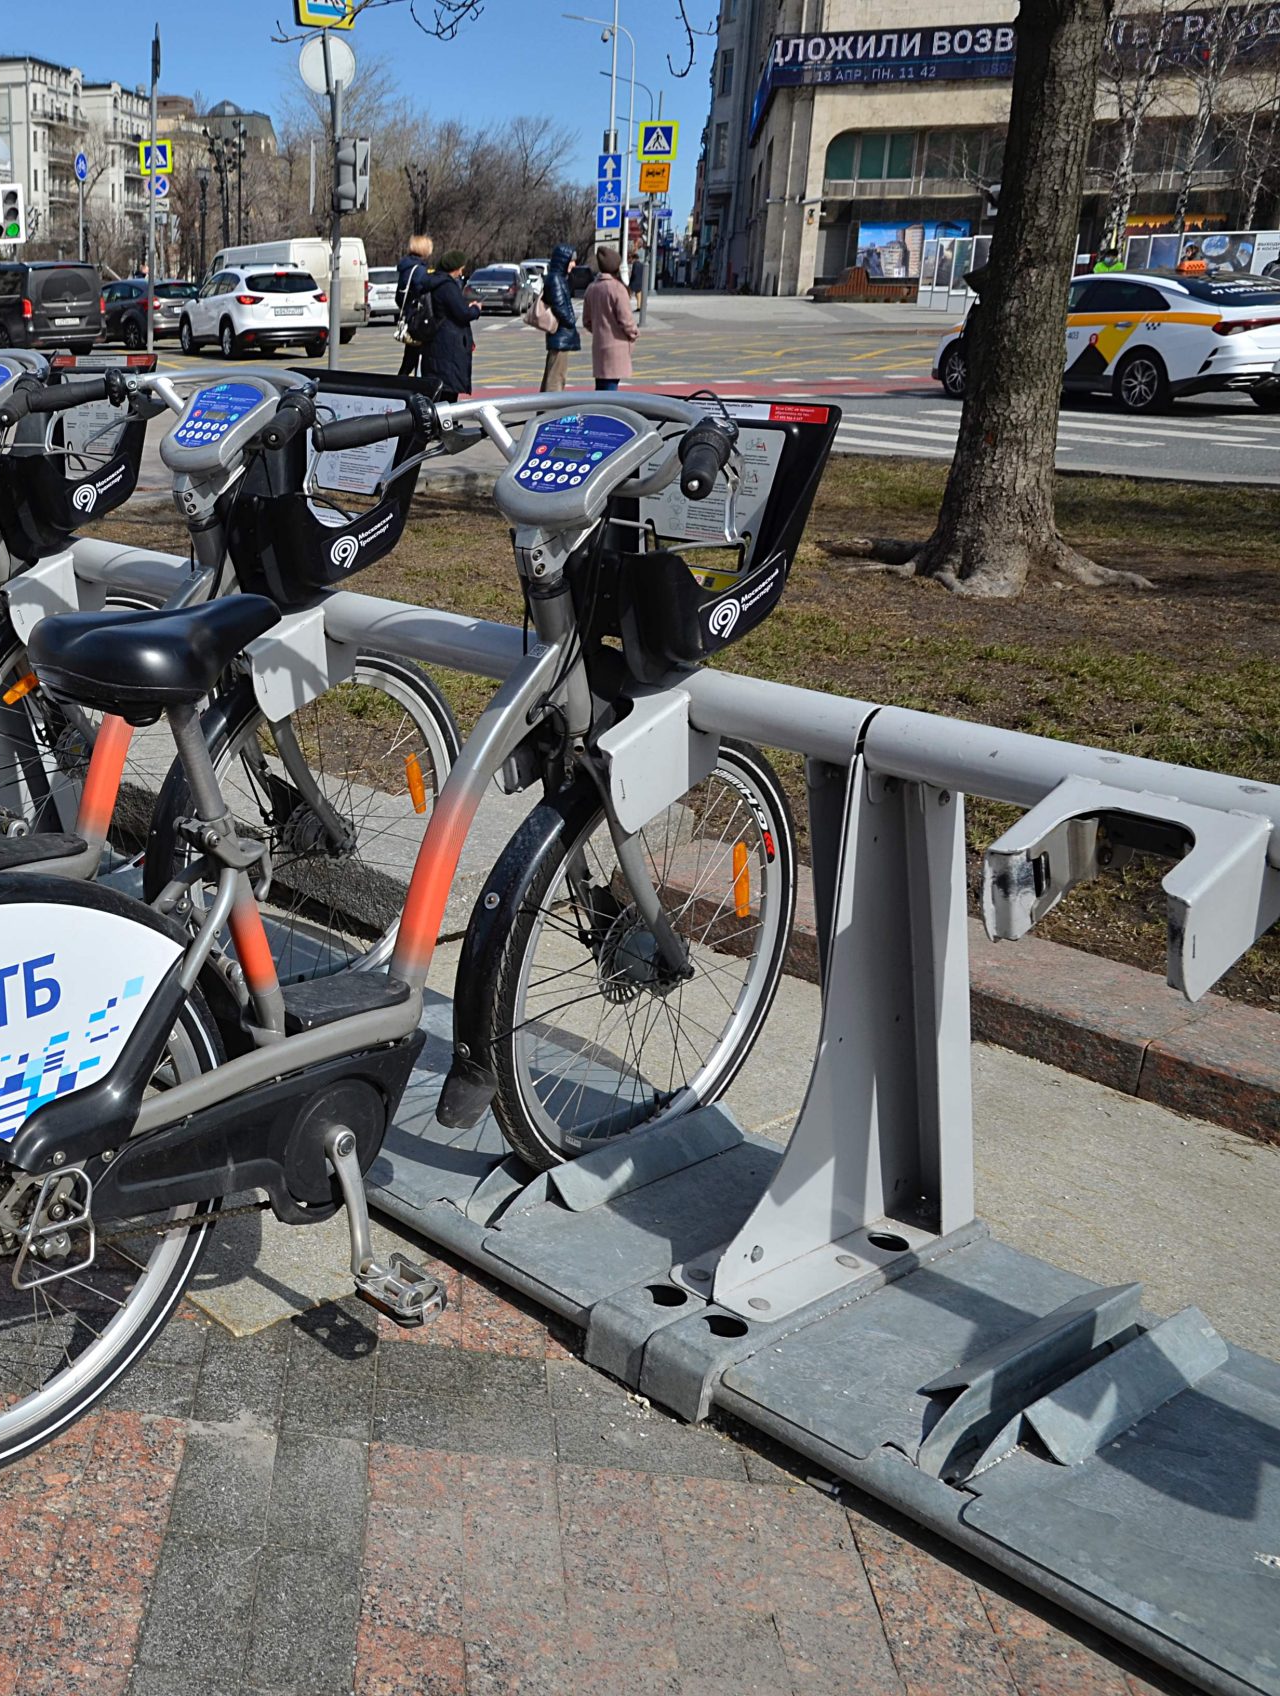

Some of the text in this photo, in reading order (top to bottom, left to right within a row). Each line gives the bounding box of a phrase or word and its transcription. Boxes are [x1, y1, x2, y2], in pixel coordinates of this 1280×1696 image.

[931, 27, 1014, 56] ВОЗВ
[96, 464, 126, 488] Московский
[97, 474, 122, 494] Транспорт
[358, 512, 394, 540] Московский
[359, 524, 389, 547] Транспорт
[741, 568, 779, 604] Московский
[741, 582, 774, 612] Транспорт
